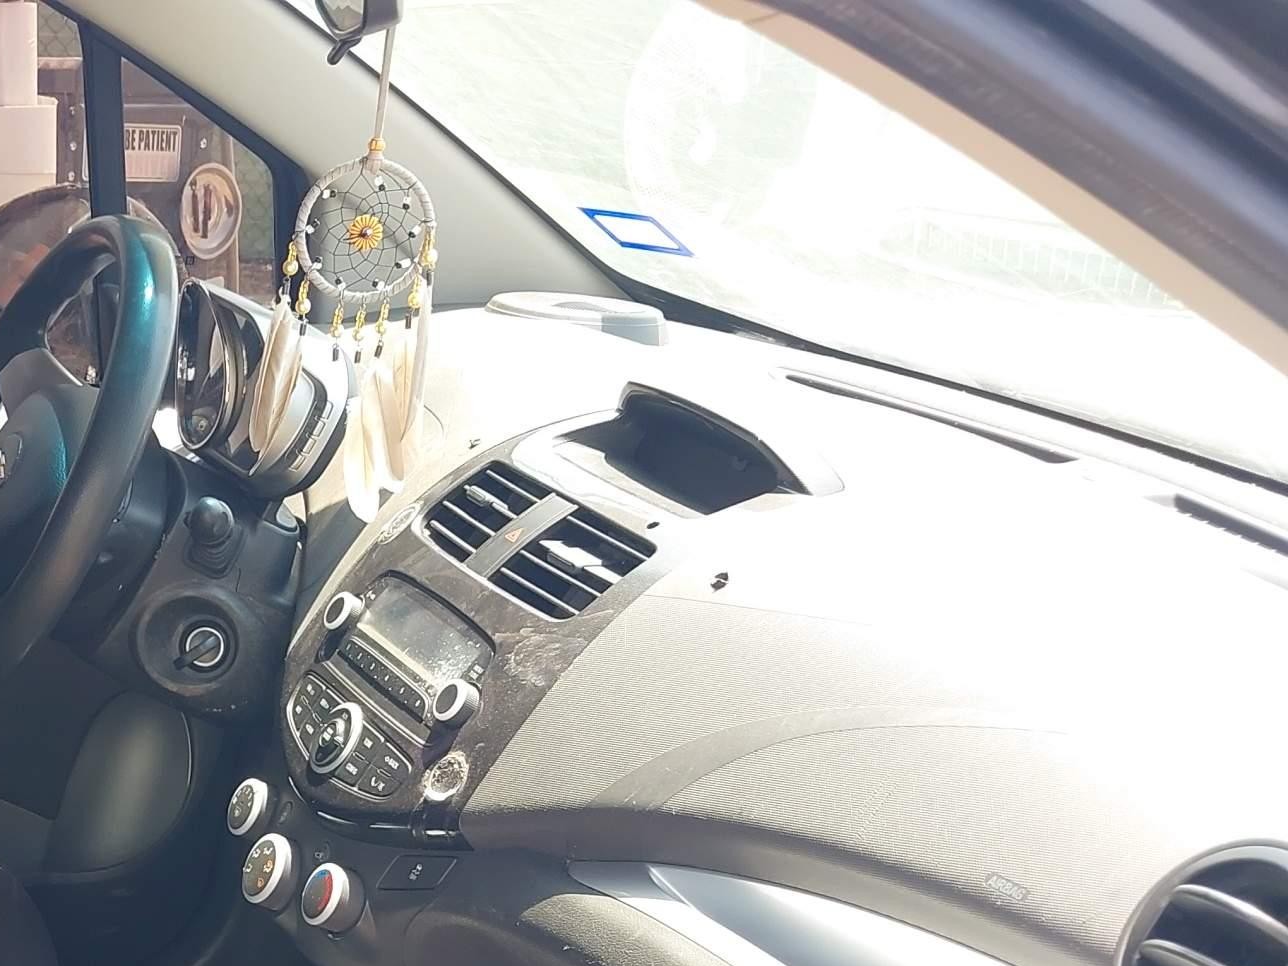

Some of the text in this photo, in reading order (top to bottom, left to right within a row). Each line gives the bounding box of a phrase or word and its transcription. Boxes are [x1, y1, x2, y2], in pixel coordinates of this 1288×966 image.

[125, 129, 178, 152] BE PATIENT
[987, 875, 1026, 900] AIRBAG
